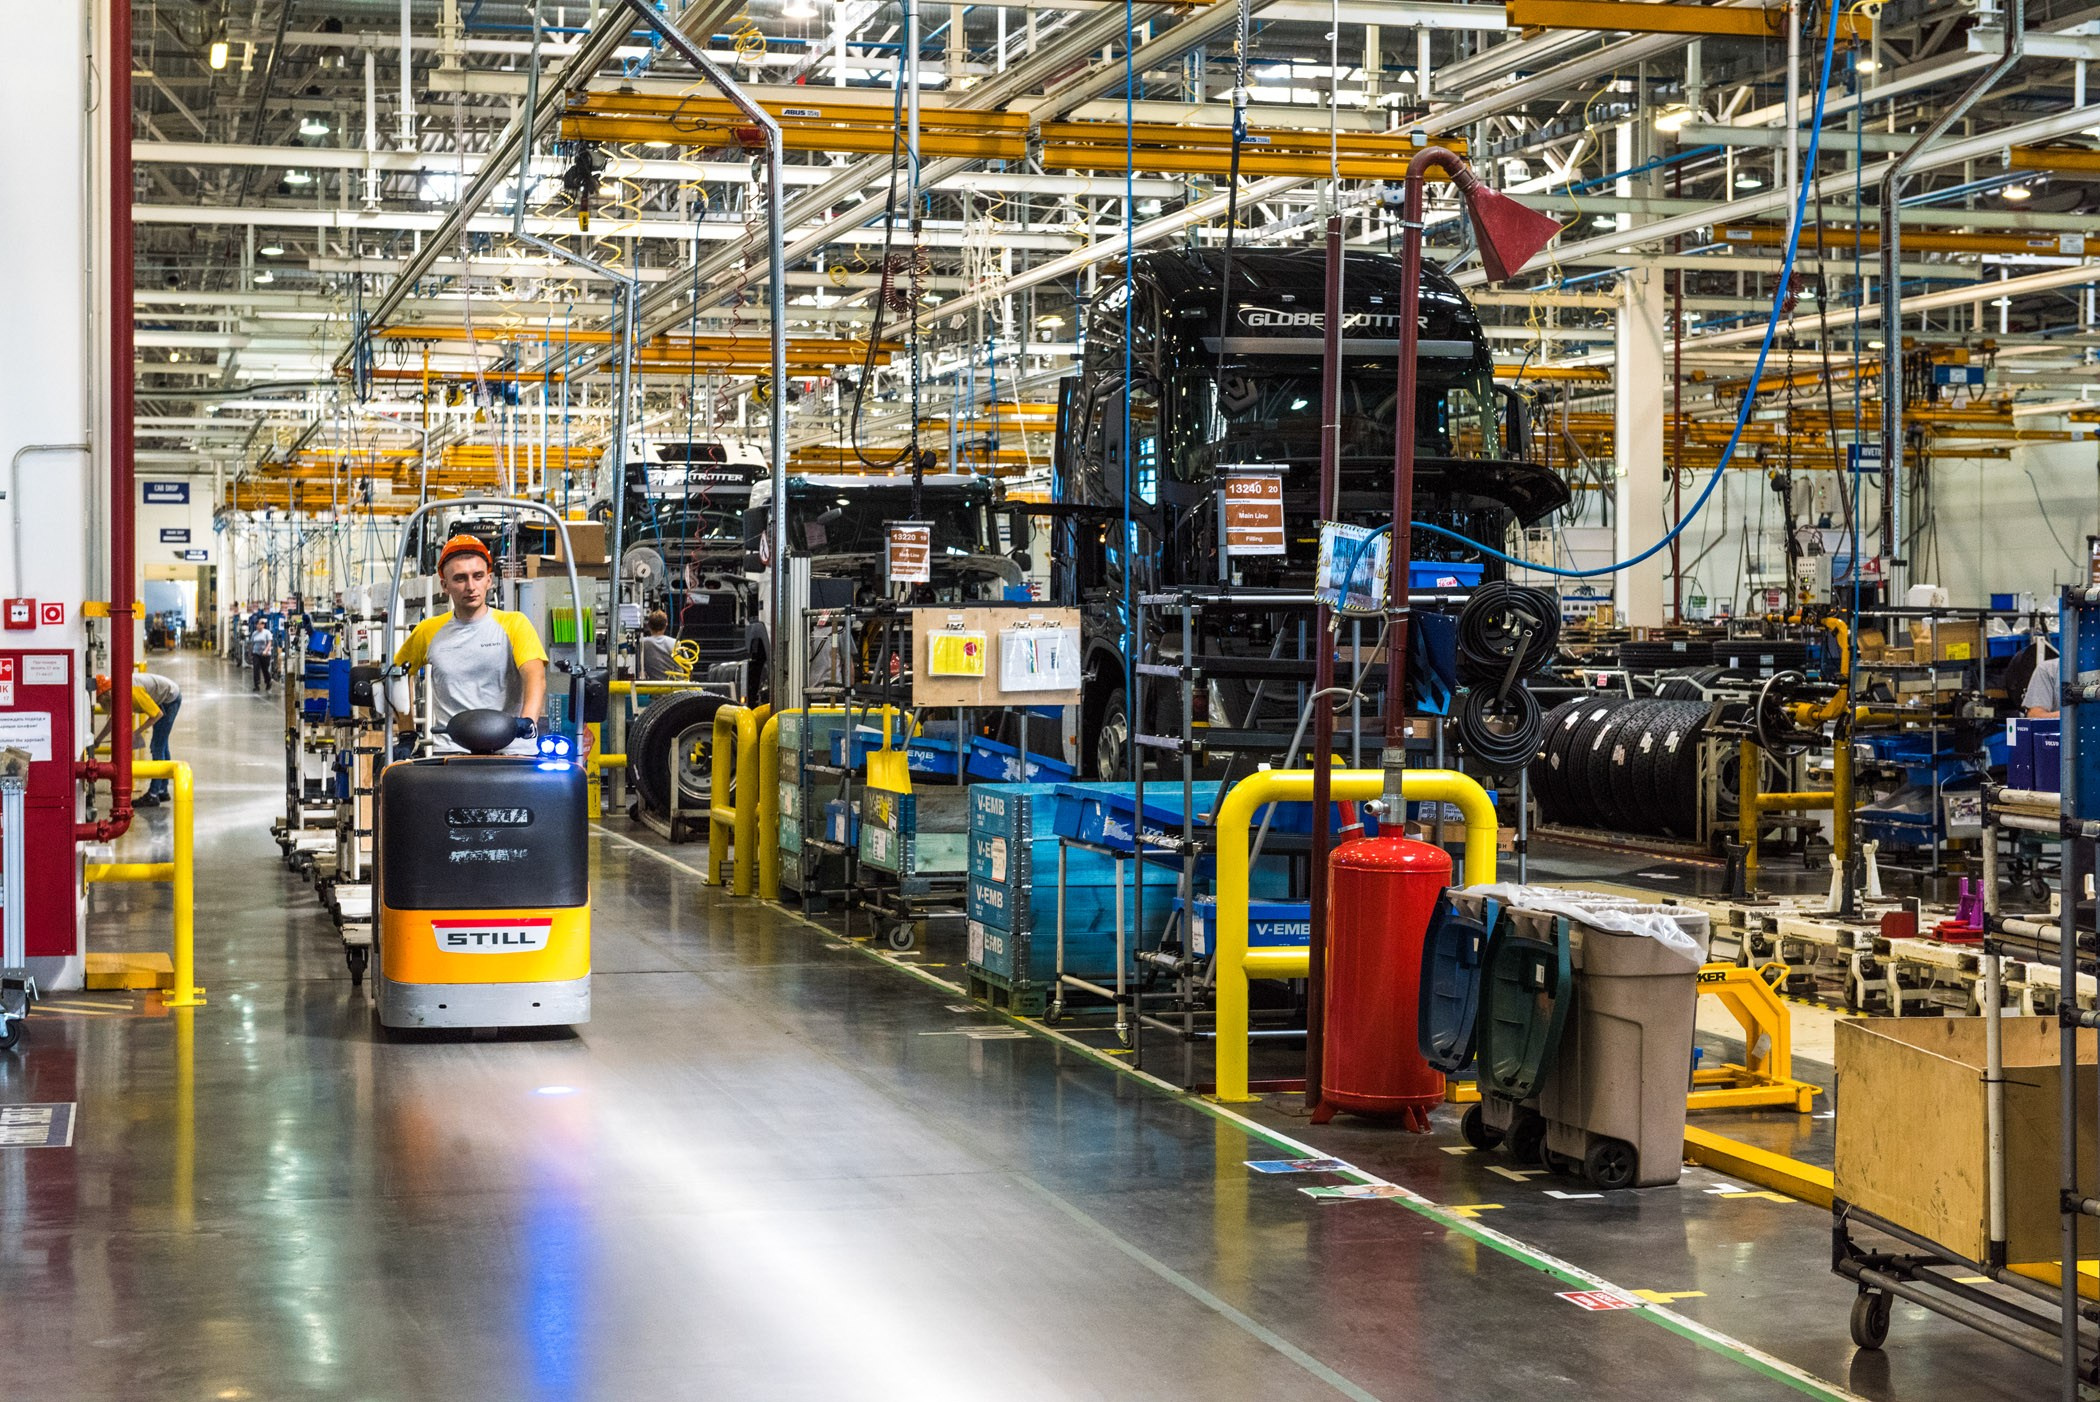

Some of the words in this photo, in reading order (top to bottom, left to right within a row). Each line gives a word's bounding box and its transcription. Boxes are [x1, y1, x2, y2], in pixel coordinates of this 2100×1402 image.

[1247, 312, 1429, 329] GLOBEROTTR
[1229, 483, 1262, 494] 13240
[893, 533, 916, 541] 13220
[1245, 535, 1264, 543] Filling
[907, 750, 935, 760] EMB
[977, 794, 1005, 816] V-EMB
[975, 884, 1004, 909] V-EMB
[1255, 923, 1311, 935] V-EMB
[447, 931, 536, 946] STILL
[983, 932, 1004, 955] EMB
